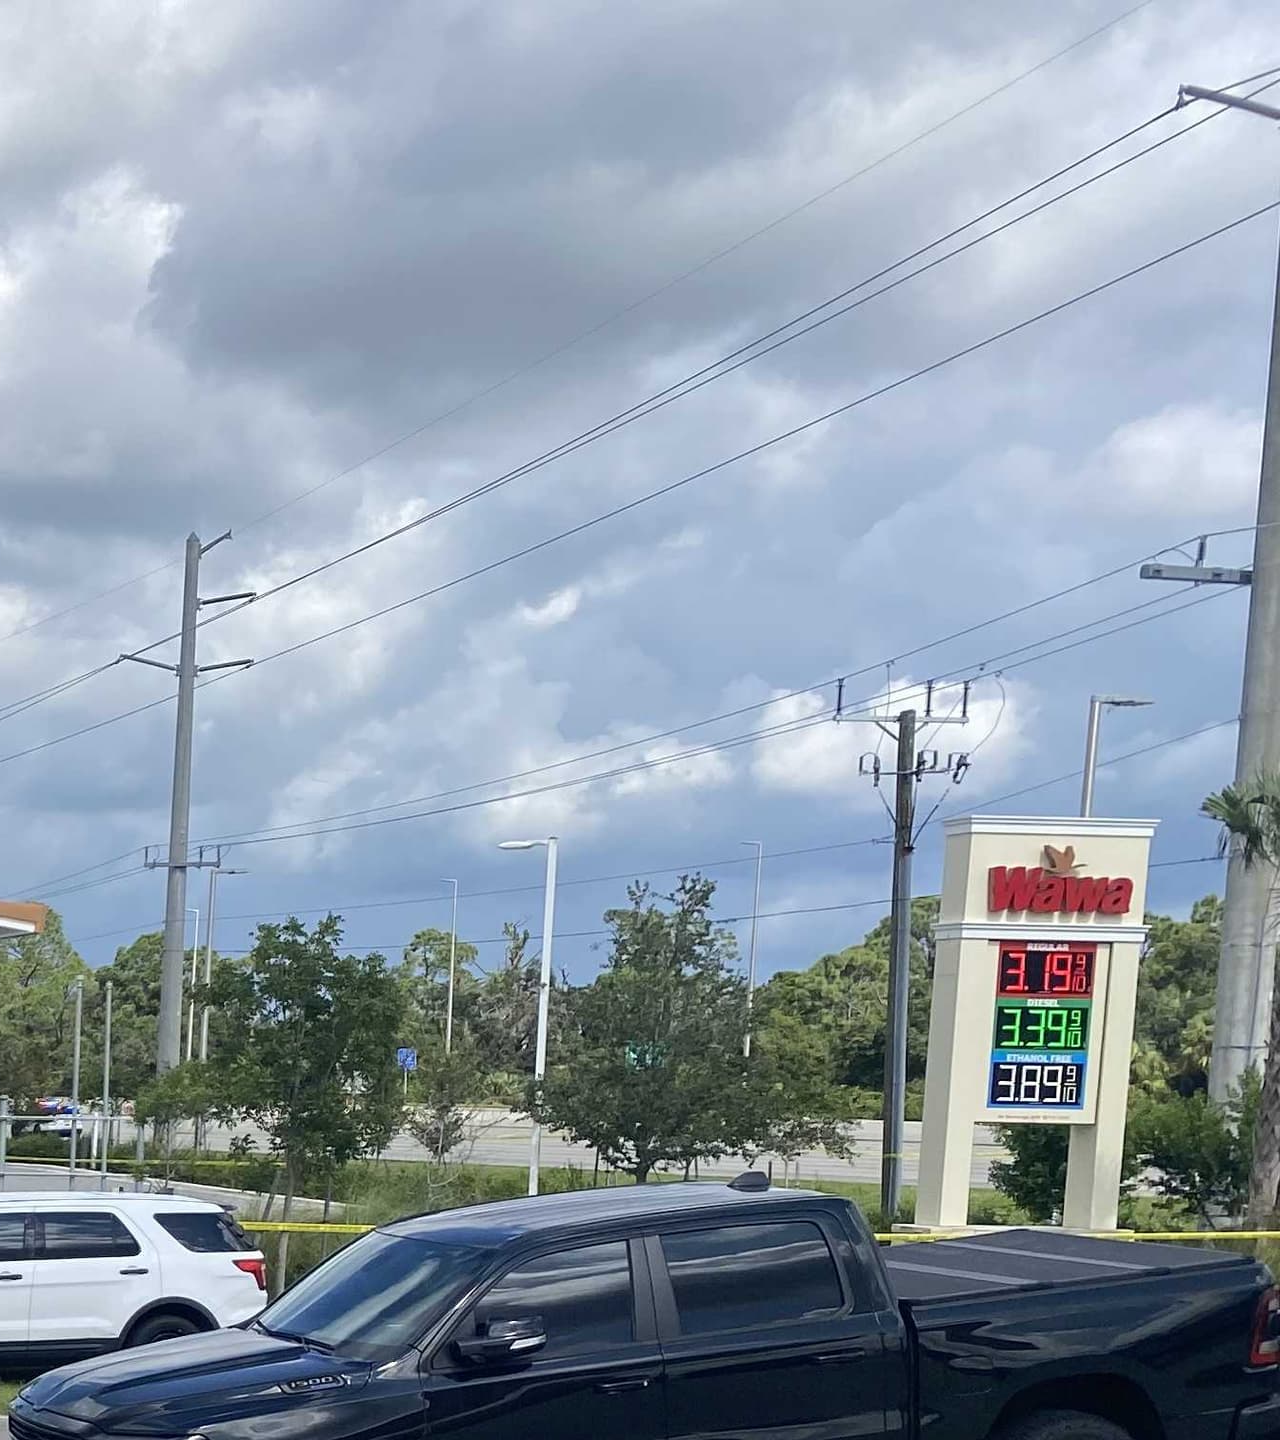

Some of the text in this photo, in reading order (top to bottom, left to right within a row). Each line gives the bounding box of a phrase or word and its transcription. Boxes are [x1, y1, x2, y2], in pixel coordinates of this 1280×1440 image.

[988, 866, 1133, 915] Wawa
[1026, 943, 1069, 952] REGULAR
[1005, 953, 1072, 991] 3.19
[1026, 999, 1060, 1008] DIESEL
[1000, 1009, 1068, 1047] 3.39
[1006, 1053, 1073, 1064] ETHANOL FREE
[996, 1065, 1063, 1103] 3.89
